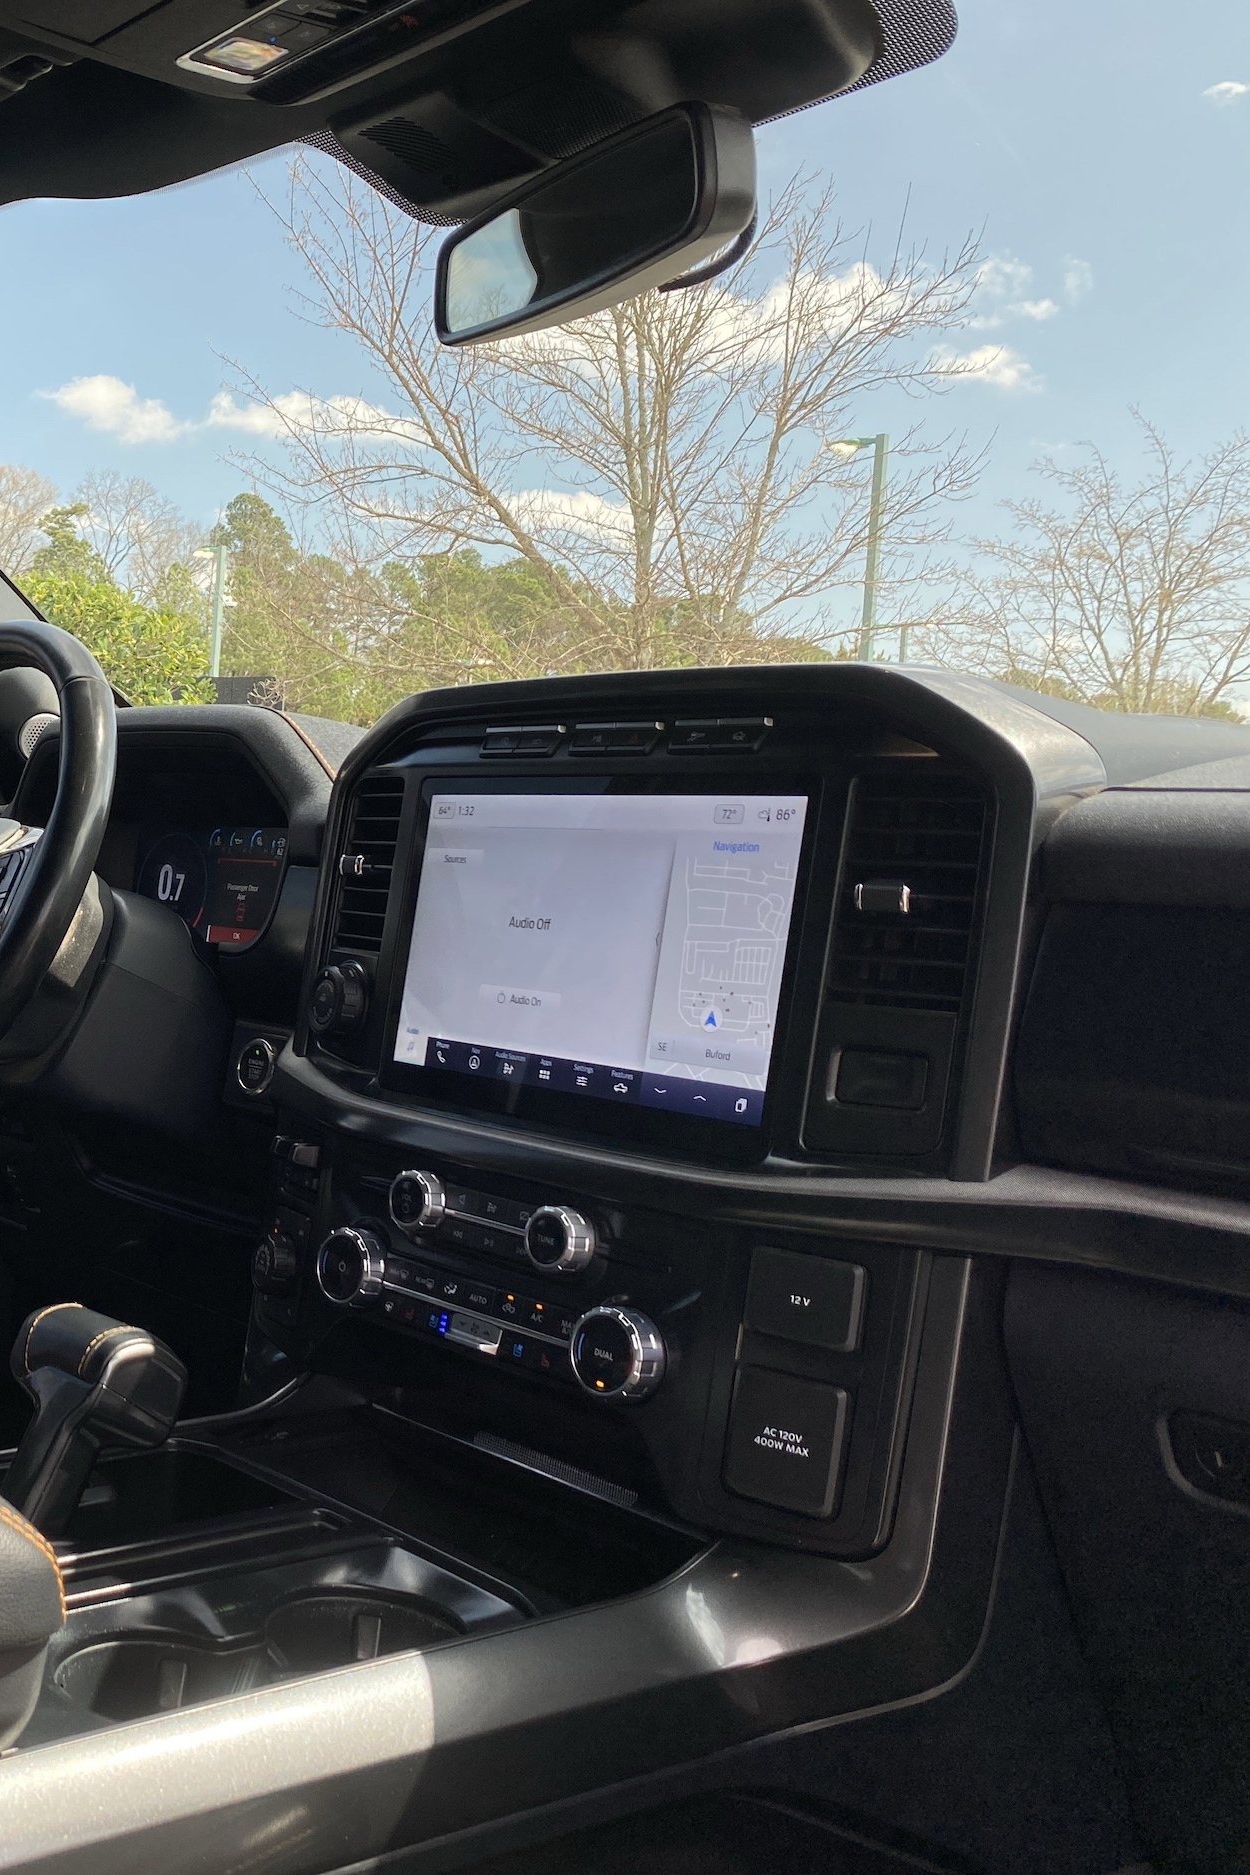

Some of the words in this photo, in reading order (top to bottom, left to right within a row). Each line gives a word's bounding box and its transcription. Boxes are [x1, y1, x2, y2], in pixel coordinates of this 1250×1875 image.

[458, 806, 475, 816] 1:32
[776, 809, 796, 821] 86°
[713, 841, 760, 854] Navigation
[444, 854, 467, 864] Sources
[157, 863, 186, 901] 0.7
[509, 916, 535, 930] Audio
[536, 918, 551, 930] Off
[510, 993, 530, 1005] Audio
[531, 996, 541, 1006] On
[657, 1042, 667, 1052] SE
[705, 1048, 731, 1061] Buford
[469, 1292, 487, 1305] AUTO
[790, 1294, 802, 1305] 12
[802, 1297, 811, 1307] V
[530, 1313, 543, 1324] A/C
[594, 1347, 614, 1362] DUAL
[763, 1426, 777, 1437] AC
[779, 1429, 803, 1444] 120V
[754, 1434, 784, 1450] 400W
[785, 1442, 810, 1458] MAX
